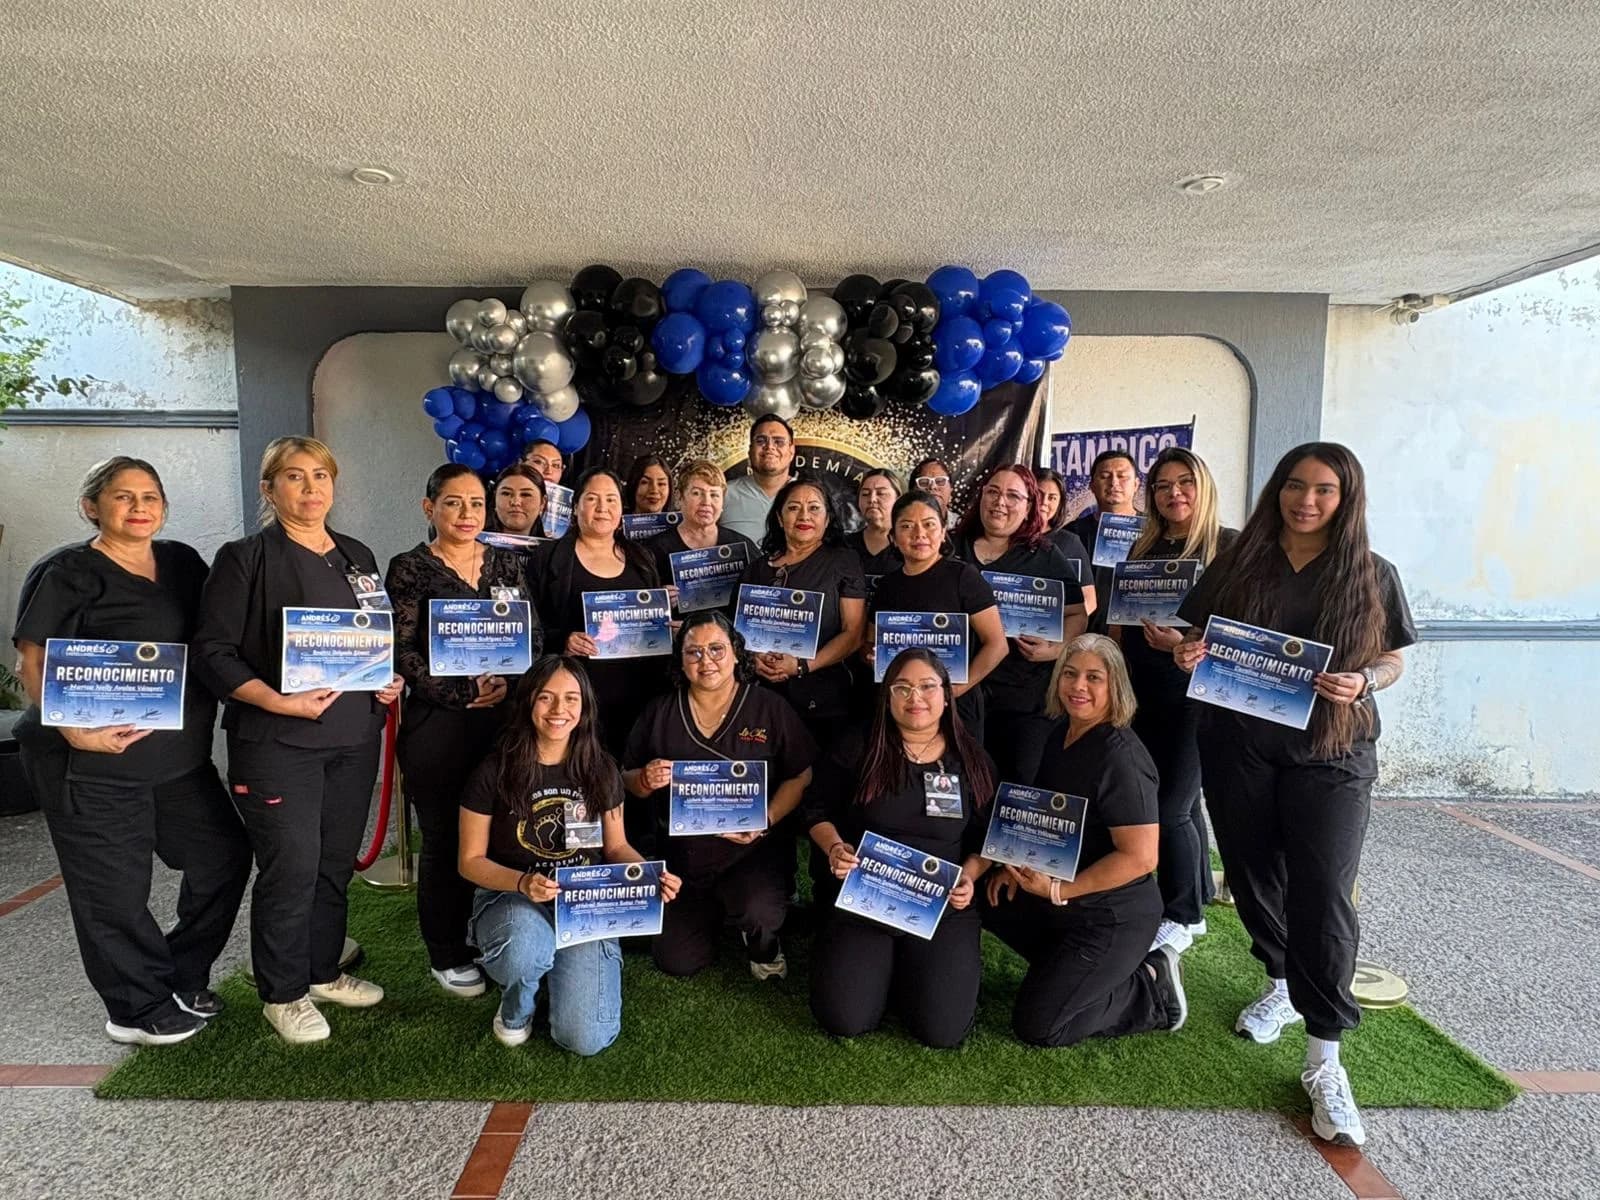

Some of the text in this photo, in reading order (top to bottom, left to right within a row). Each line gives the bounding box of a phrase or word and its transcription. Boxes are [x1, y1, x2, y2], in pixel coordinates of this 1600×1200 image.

[1104, 527, 1142, 541] RECONOCI
[679, 560, 745, 580] RECONOCIMIENTO
[1118, 578, 1188, 590] RECONOCIMIENTO
[993, 590, 1058, 607] ECONOCIMIENTO
[591, 607, 664, 622] RECONOCIMIENTO
[743, 603, 814, 622] RECONOCIMIENTO
[437, 621, 523, 635] RECONOCIMIENTO
[295, 632, 385, 648] RECONOCIMIENTO
[883, 632, 961, 645] RECONOCIMIENTO
[66, 643, 105, 653] ANDRÉS
[1209, 642, 1314, 683] RECONOCIMIENTO
[56, 666, 175, 683] RECONOCIMIENTO
[543, 788, 558, 796] son
[560, 787, 571, 796] un
[678, 783, 759, 796] RECONOCIMIENTO
[1000, 805, 1076, 835] RECONOCIMIENTO
[571, 868, 601, 879] ANDRÉS
[860, 856, 945, 898] RECONOCIMIENTO
[564, 885, 656, 903] RECONOCIMIENTO
